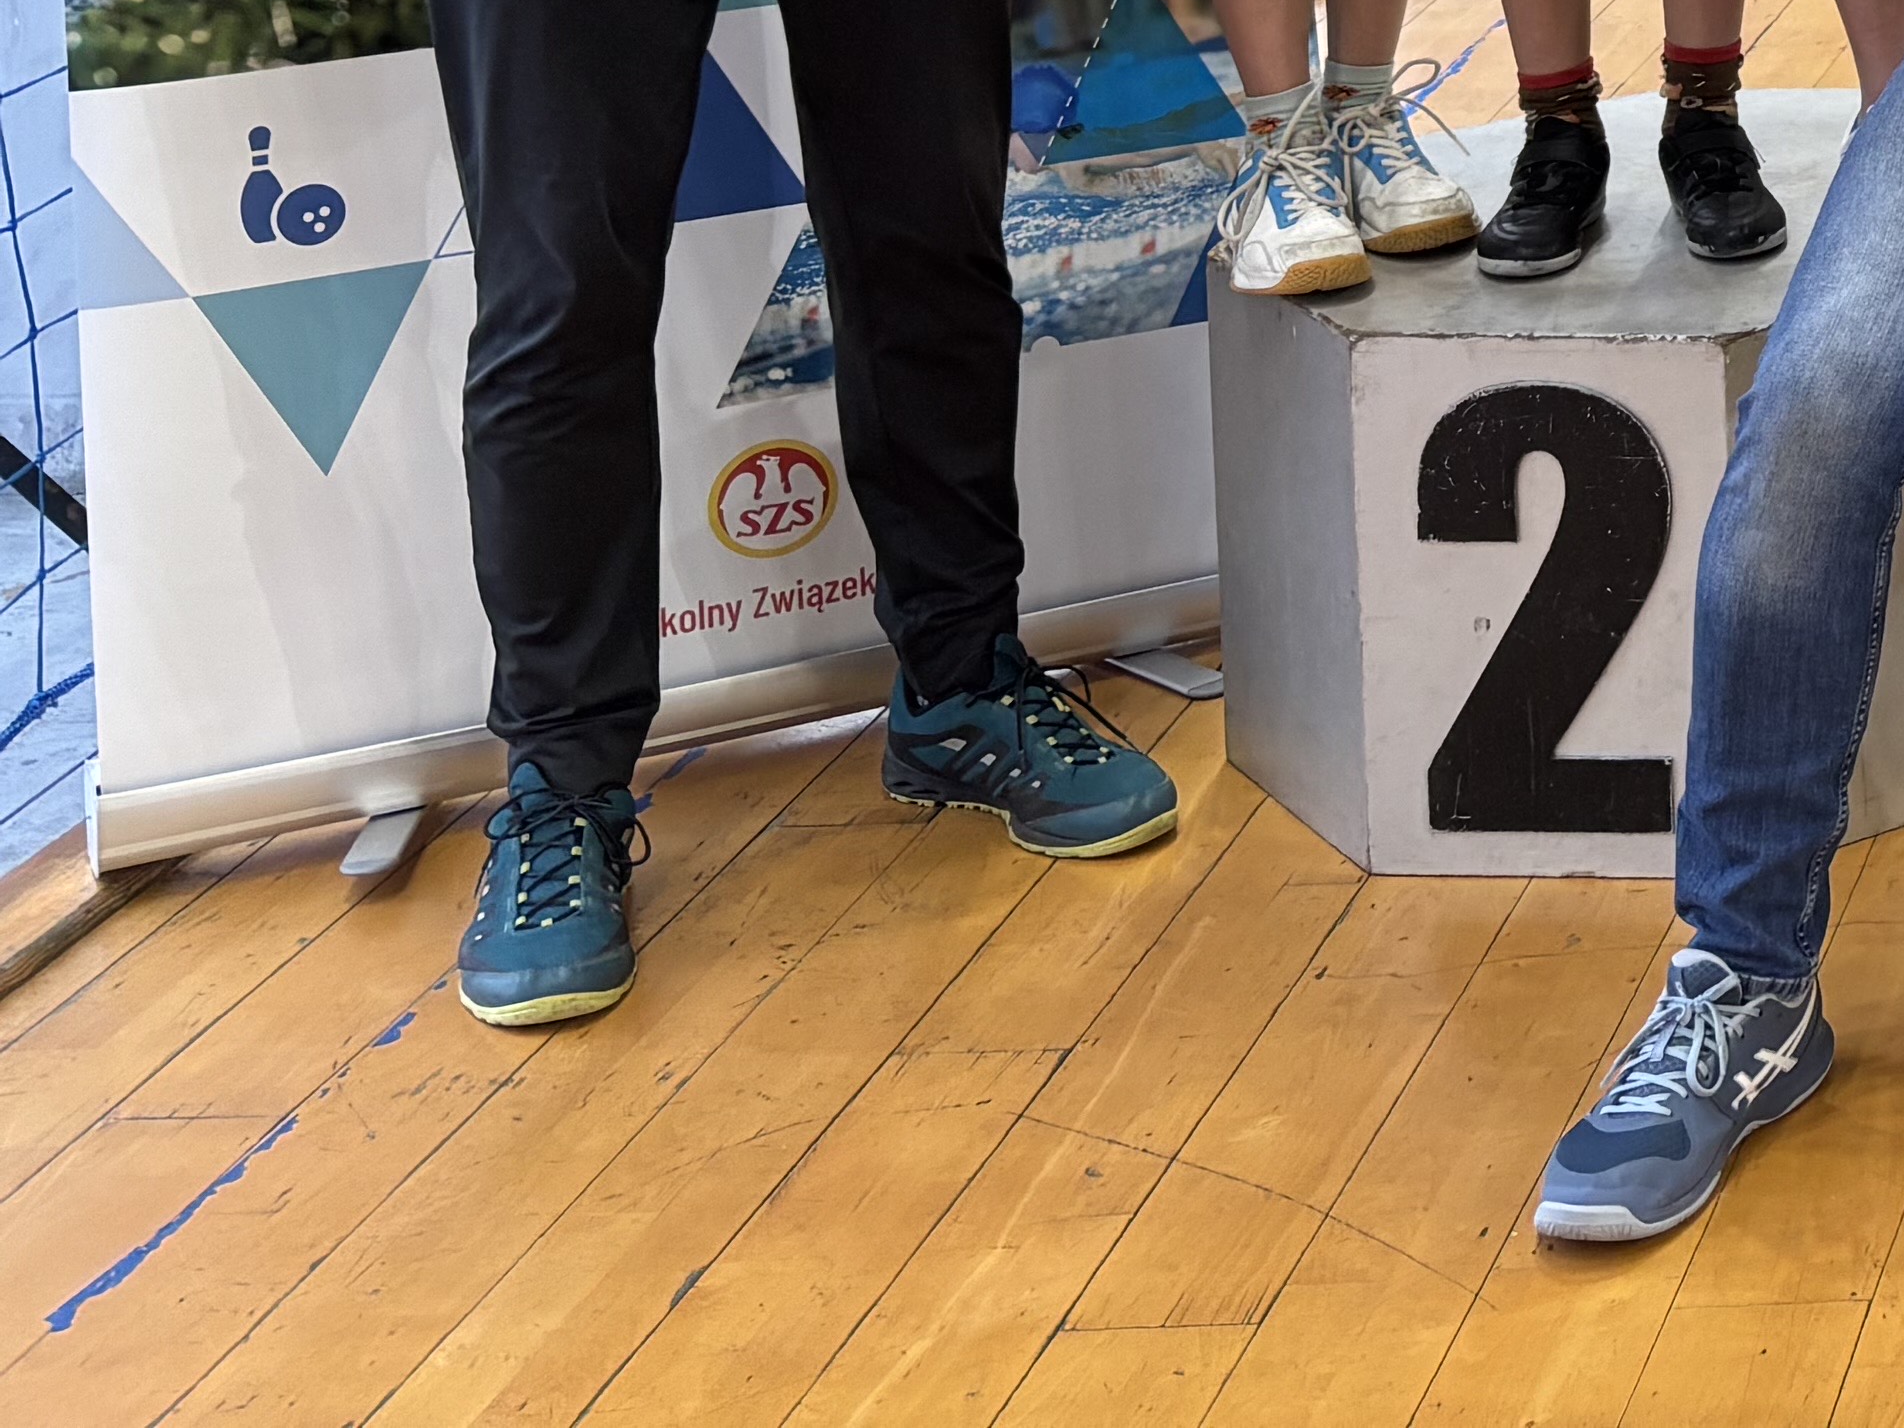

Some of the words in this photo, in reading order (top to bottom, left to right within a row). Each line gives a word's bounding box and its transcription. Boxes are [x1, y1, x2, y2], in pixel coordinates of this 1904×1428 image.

[735, 497, 816, 540] SZS
[659, 592, 744, 641] kolny
[752, 564, 877, 622] Związek
[1417, 380, 1674, 833] 2
